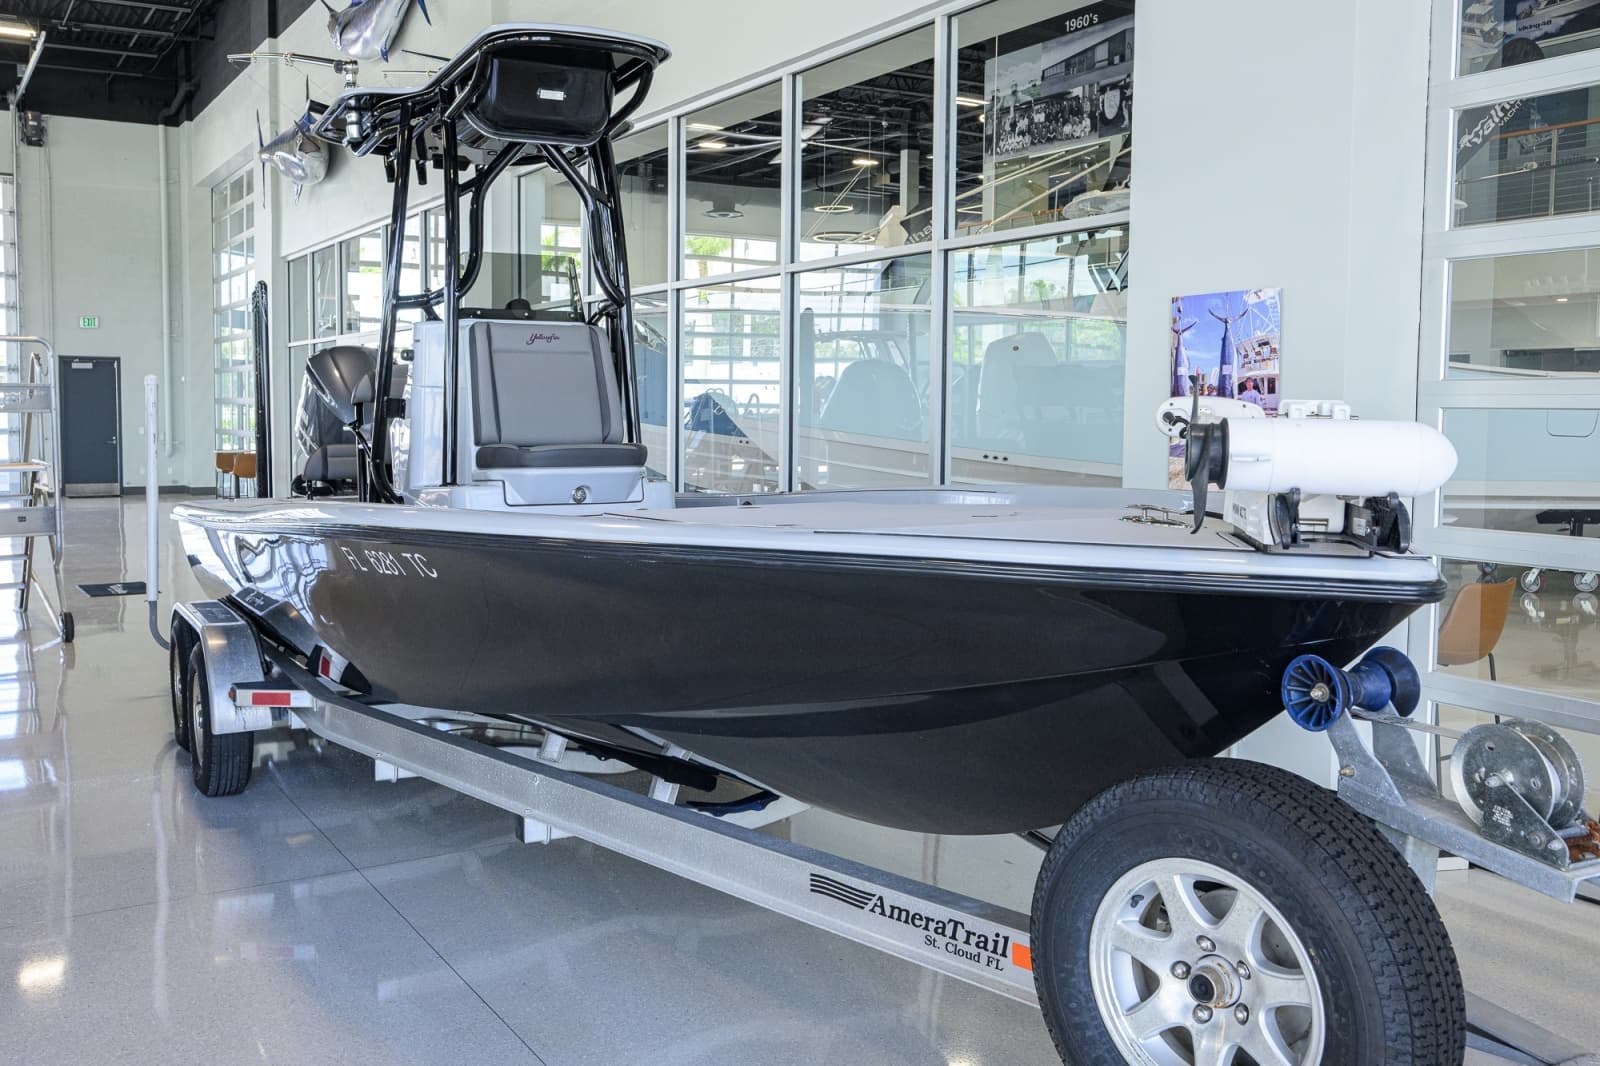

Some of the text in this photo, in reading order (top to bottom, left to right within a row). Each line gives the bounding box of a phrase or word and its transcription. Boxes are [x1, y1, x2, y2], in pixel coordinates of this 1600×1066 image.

[1065, 13, 1099, 32] 1960's
[82, 316, 97, 328] EXIT
[340, 546, 438, 578] FL 6281 TC
[869, 895, 1010, 959] AmeraTrail
[924, 934, 1004, 971] St. Cloud FL
